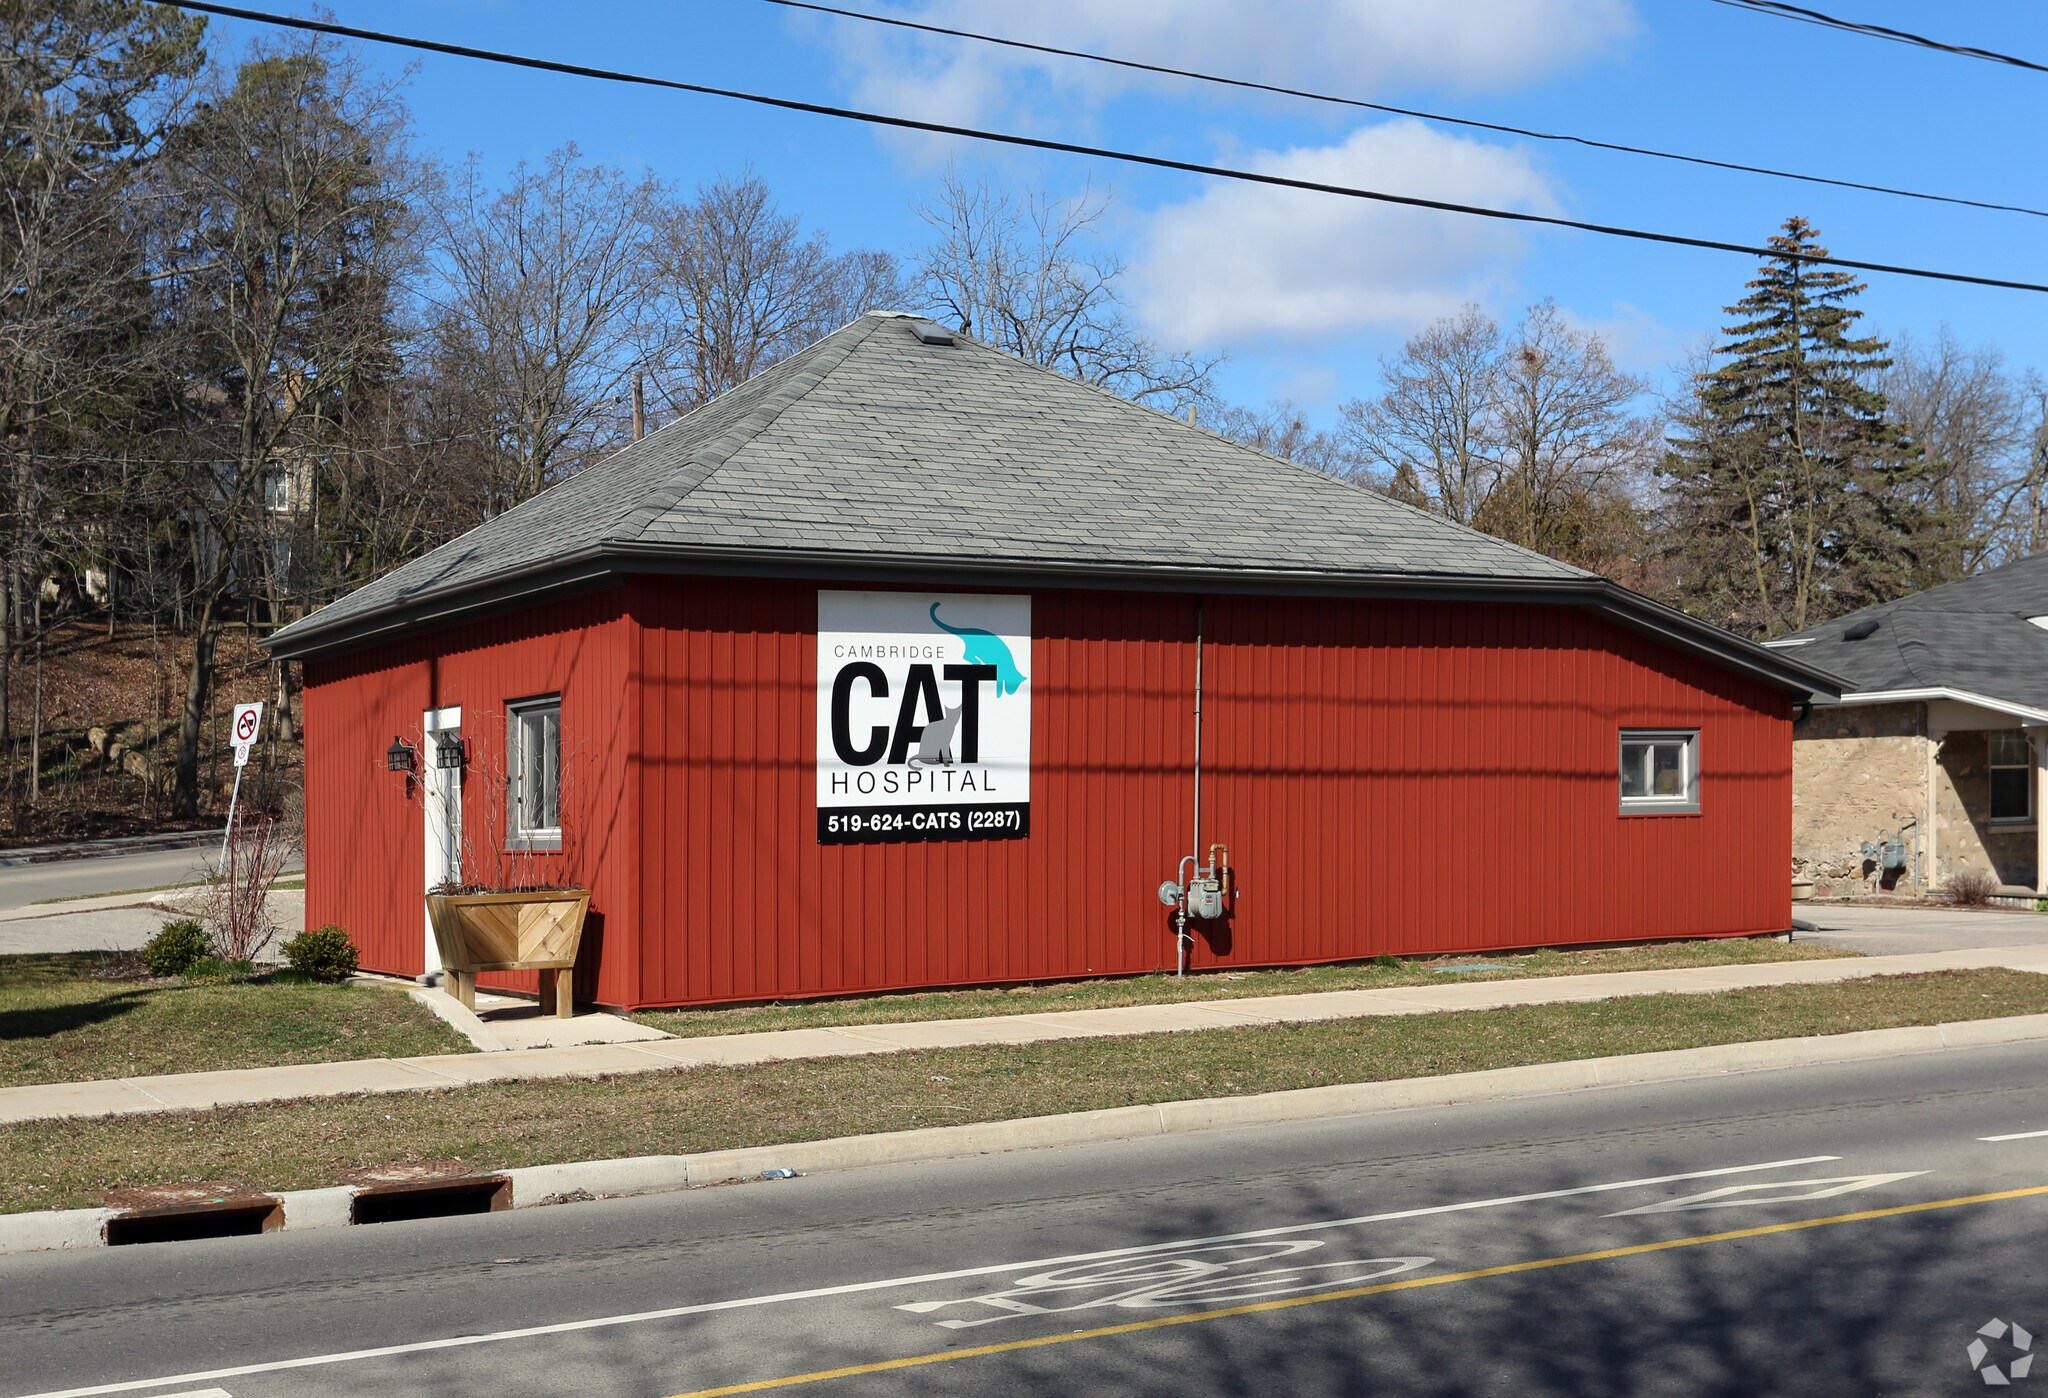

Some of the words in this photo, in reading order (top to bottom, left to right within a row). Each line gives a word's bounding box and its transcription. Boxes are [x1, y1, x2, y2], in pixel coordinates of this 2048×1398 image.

[834, 645, 944, 658] CAMBRIDGE
[831, 661, 997, 766] CAT
[832, 770, 996, 794] HOSPITAL
[828, 812, 961, 832] 519-624-CATS
[967, 810, 1020, 830] (2287)
